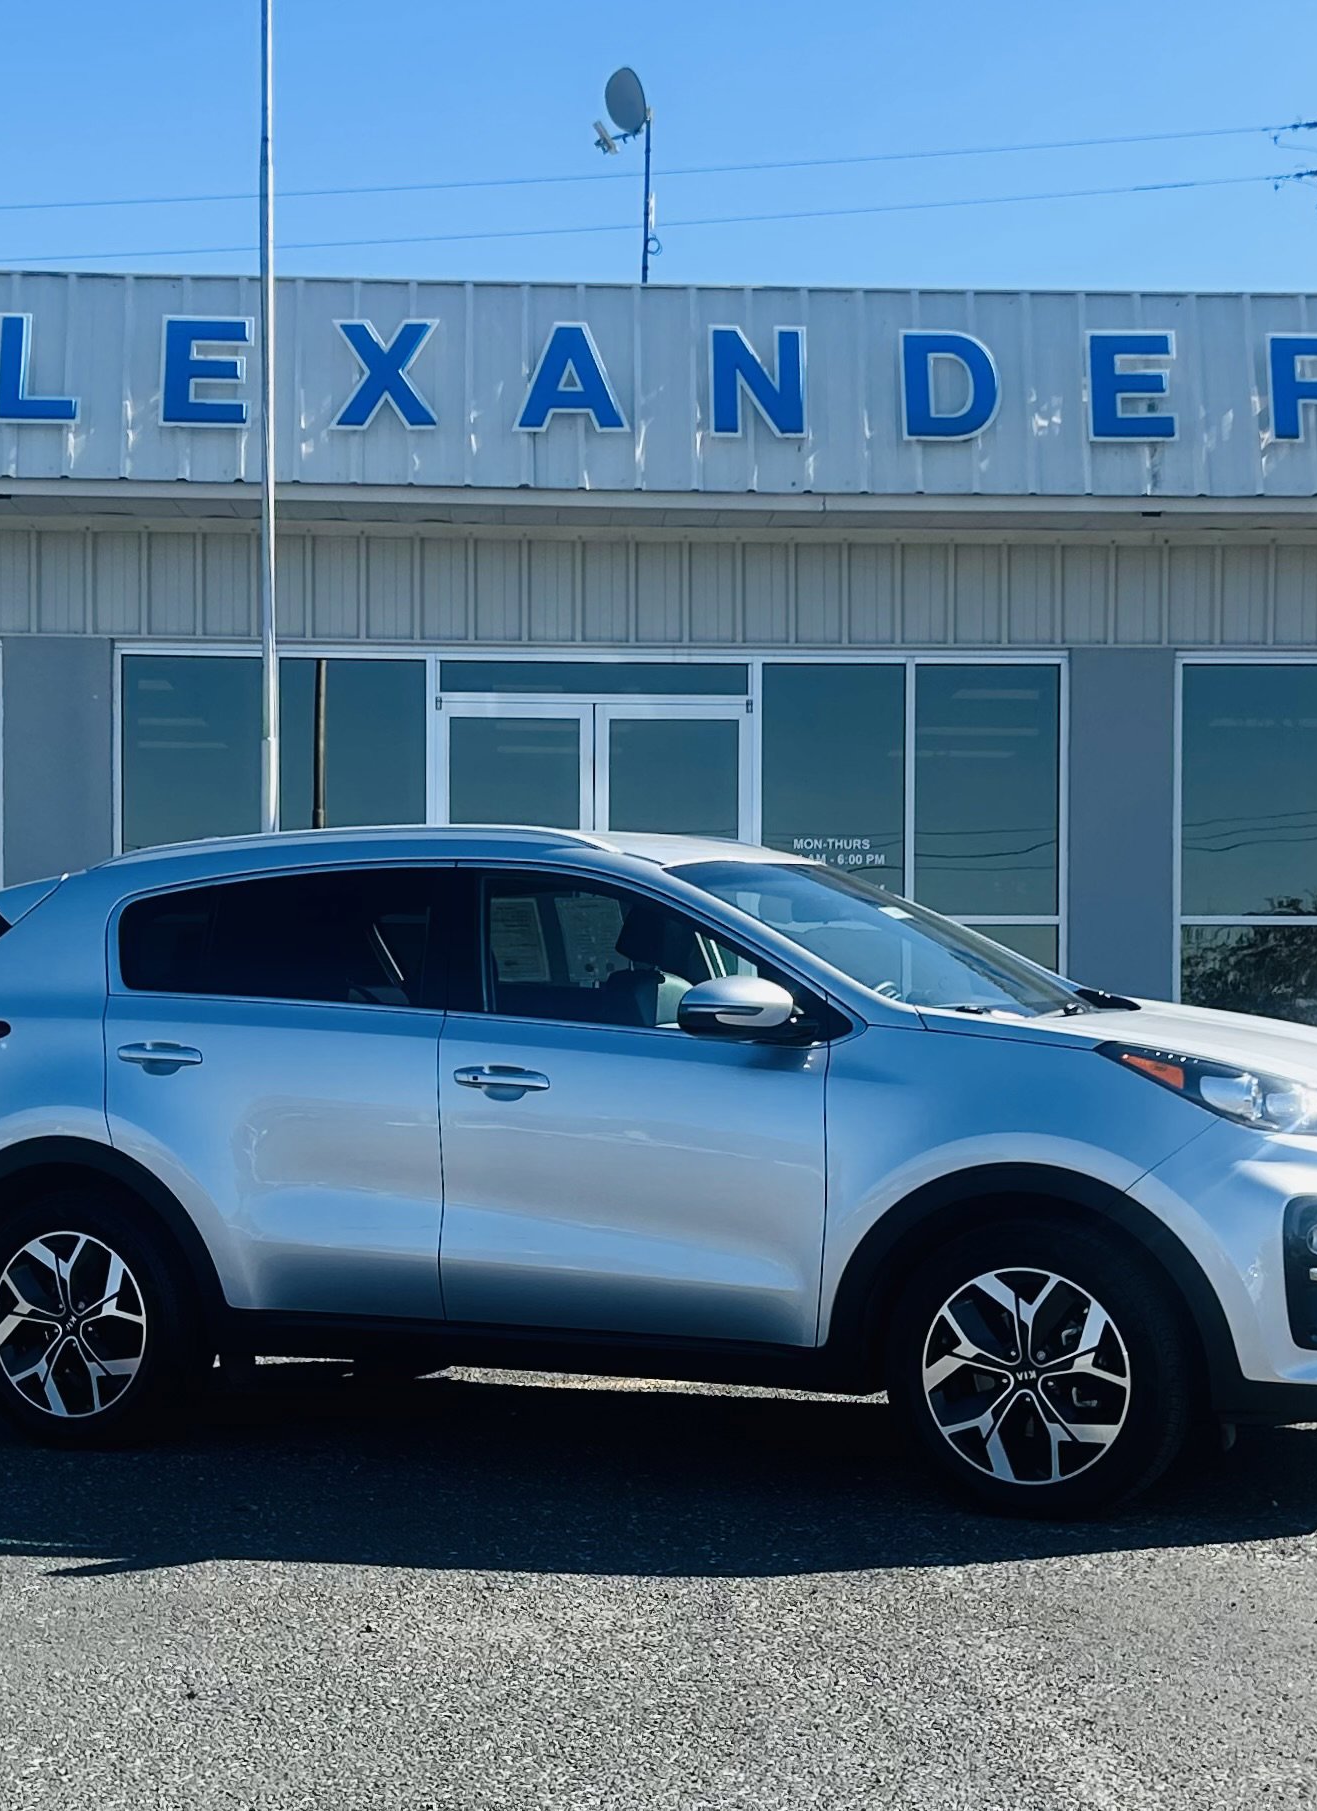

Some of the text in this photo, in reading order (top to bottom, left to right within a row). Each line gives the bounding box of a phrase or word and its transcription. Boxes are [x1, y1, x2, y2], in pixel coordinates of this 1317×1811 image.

[793, 838, 871, 850] MON-THURS
[837, 854, 863, 865] 6:00
[866, 854, 886, 865] PM
